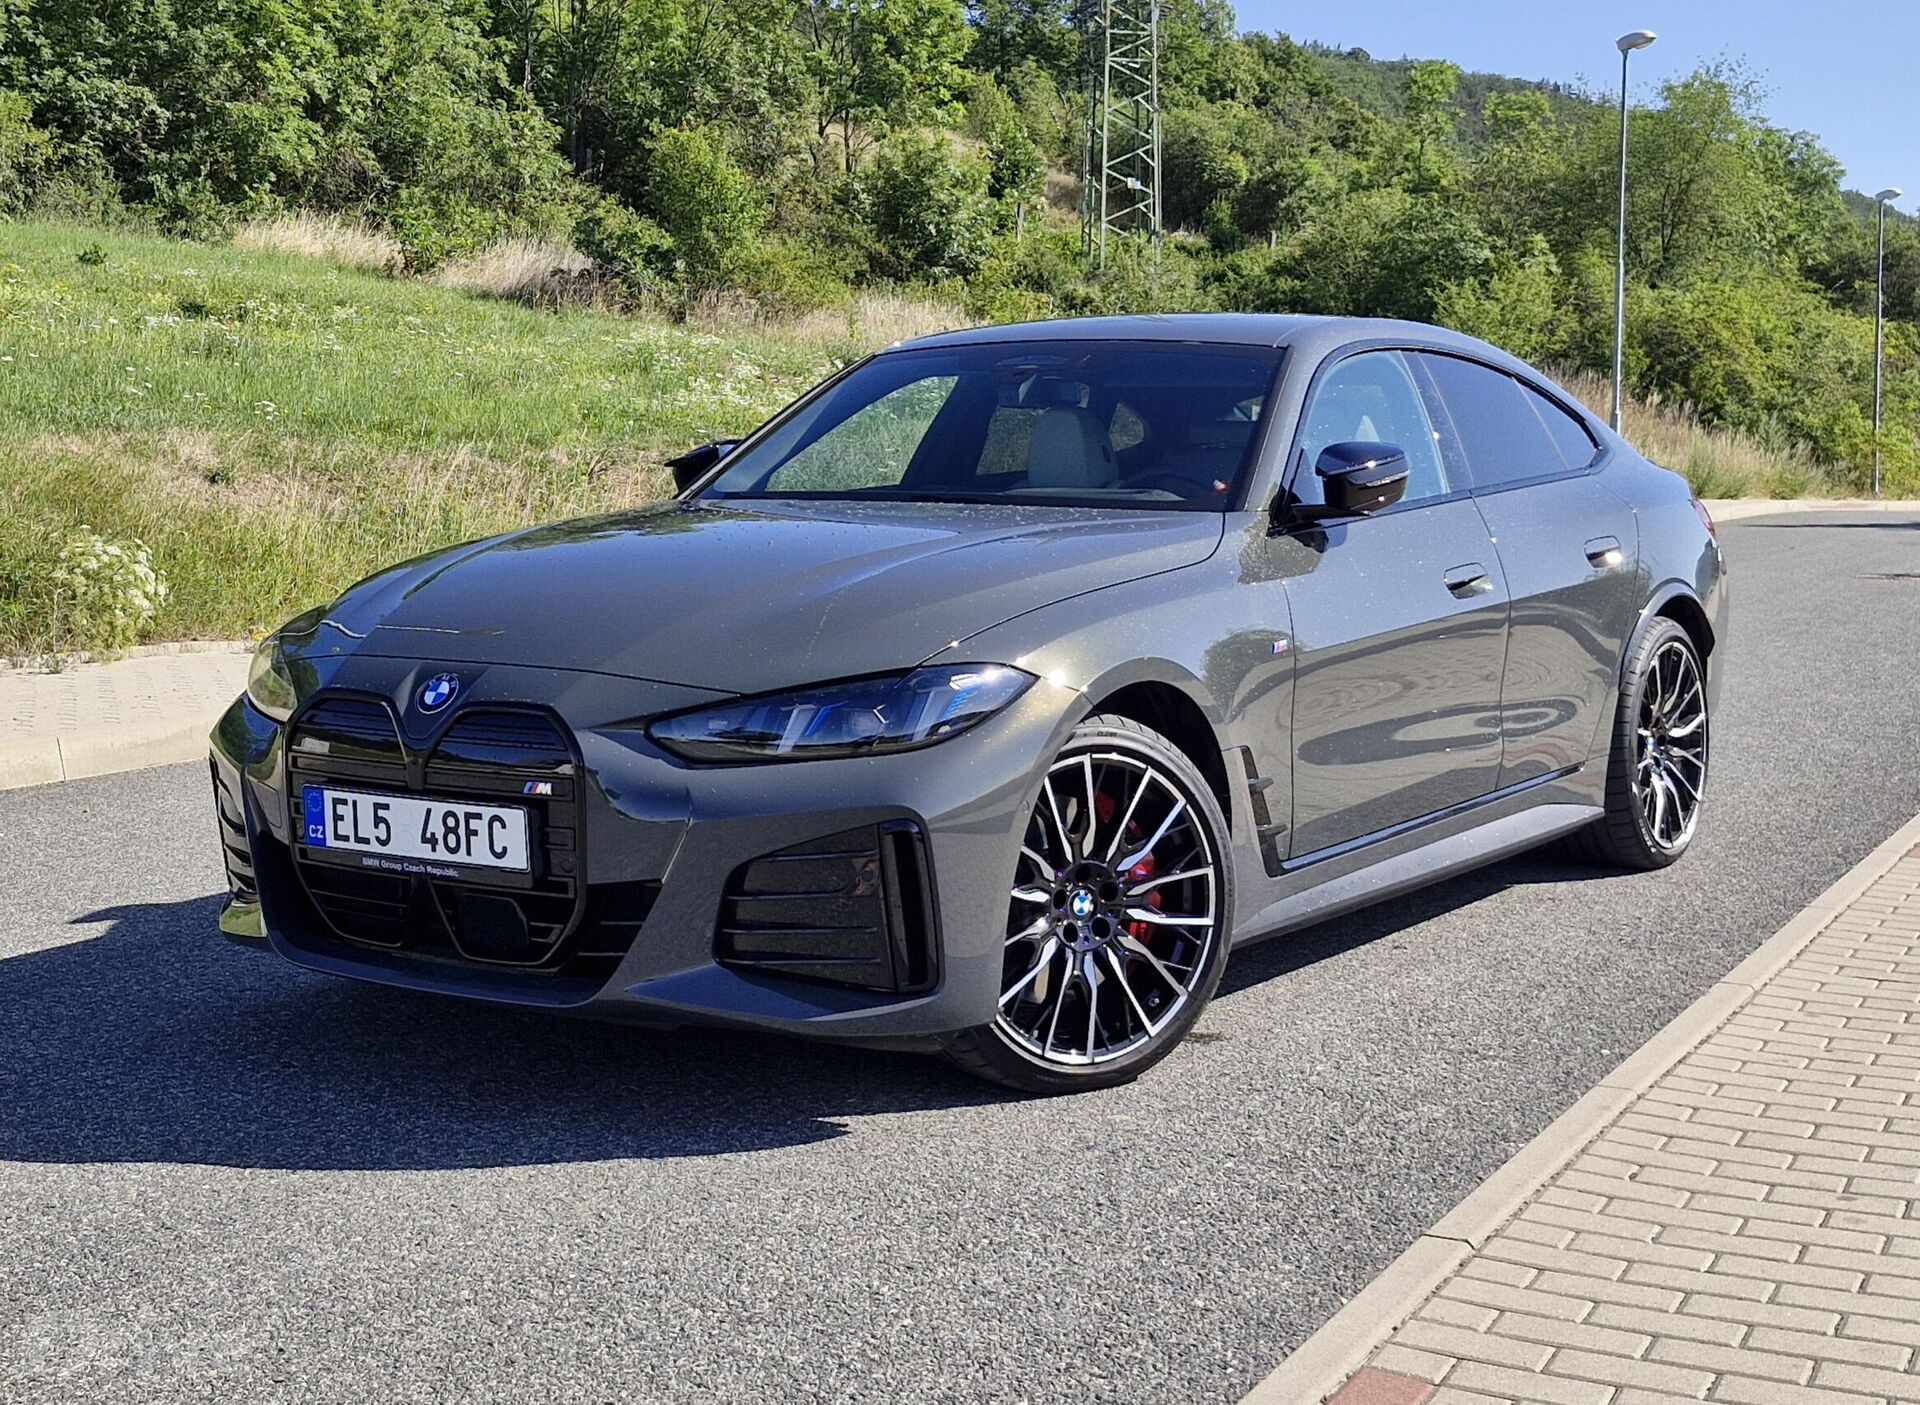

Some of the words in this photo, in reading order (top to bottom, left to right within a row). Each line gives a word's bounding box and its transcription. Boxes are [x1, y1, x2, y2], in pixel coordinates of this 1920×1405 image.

[309, 824, 324, 839] CZ
[331, 796, 392, 847] EL5
[419, 807, 508, 860] 48FC
[362, 857, 380, 868] BMW
[381, 860, 402, 872] Group
[403, 863, 425, 874] Czech
[427, 865, 459, 878] Republic
